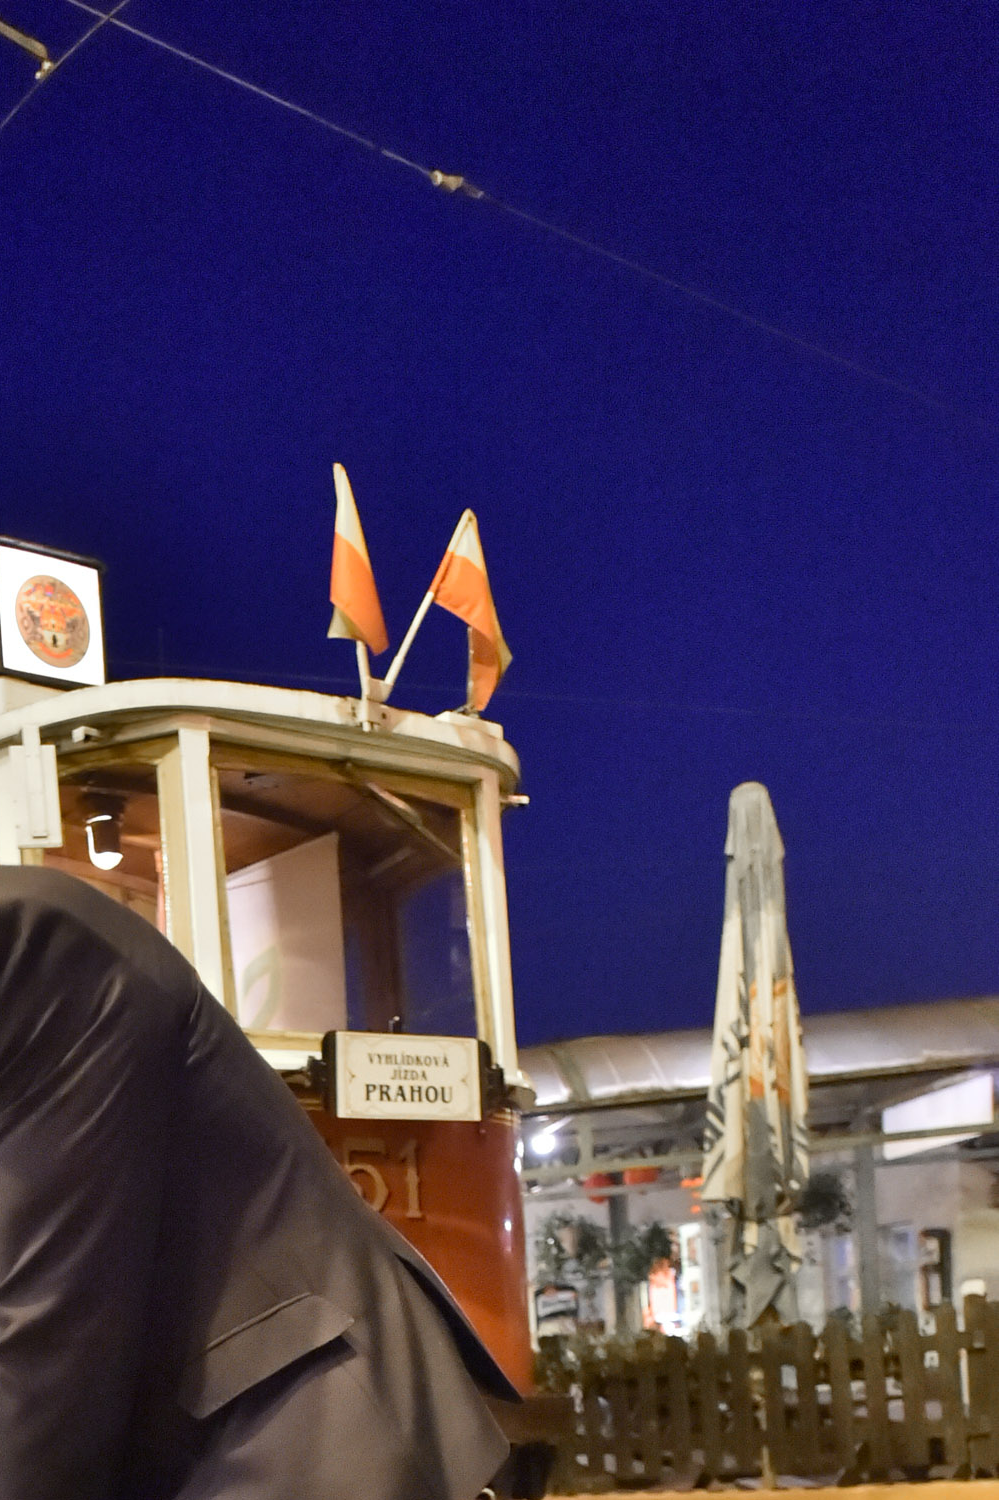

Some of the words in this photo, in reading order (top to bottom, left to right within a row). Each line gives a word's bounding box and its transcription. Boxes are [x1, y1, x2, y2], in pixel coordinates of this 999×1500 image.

[367, 1050, 450, 1068] VYHLÍDKOVÁ
[390, 1066, 428, 1081] JÍZDA
[365, 1083, 453, 1104] PRAHOU
